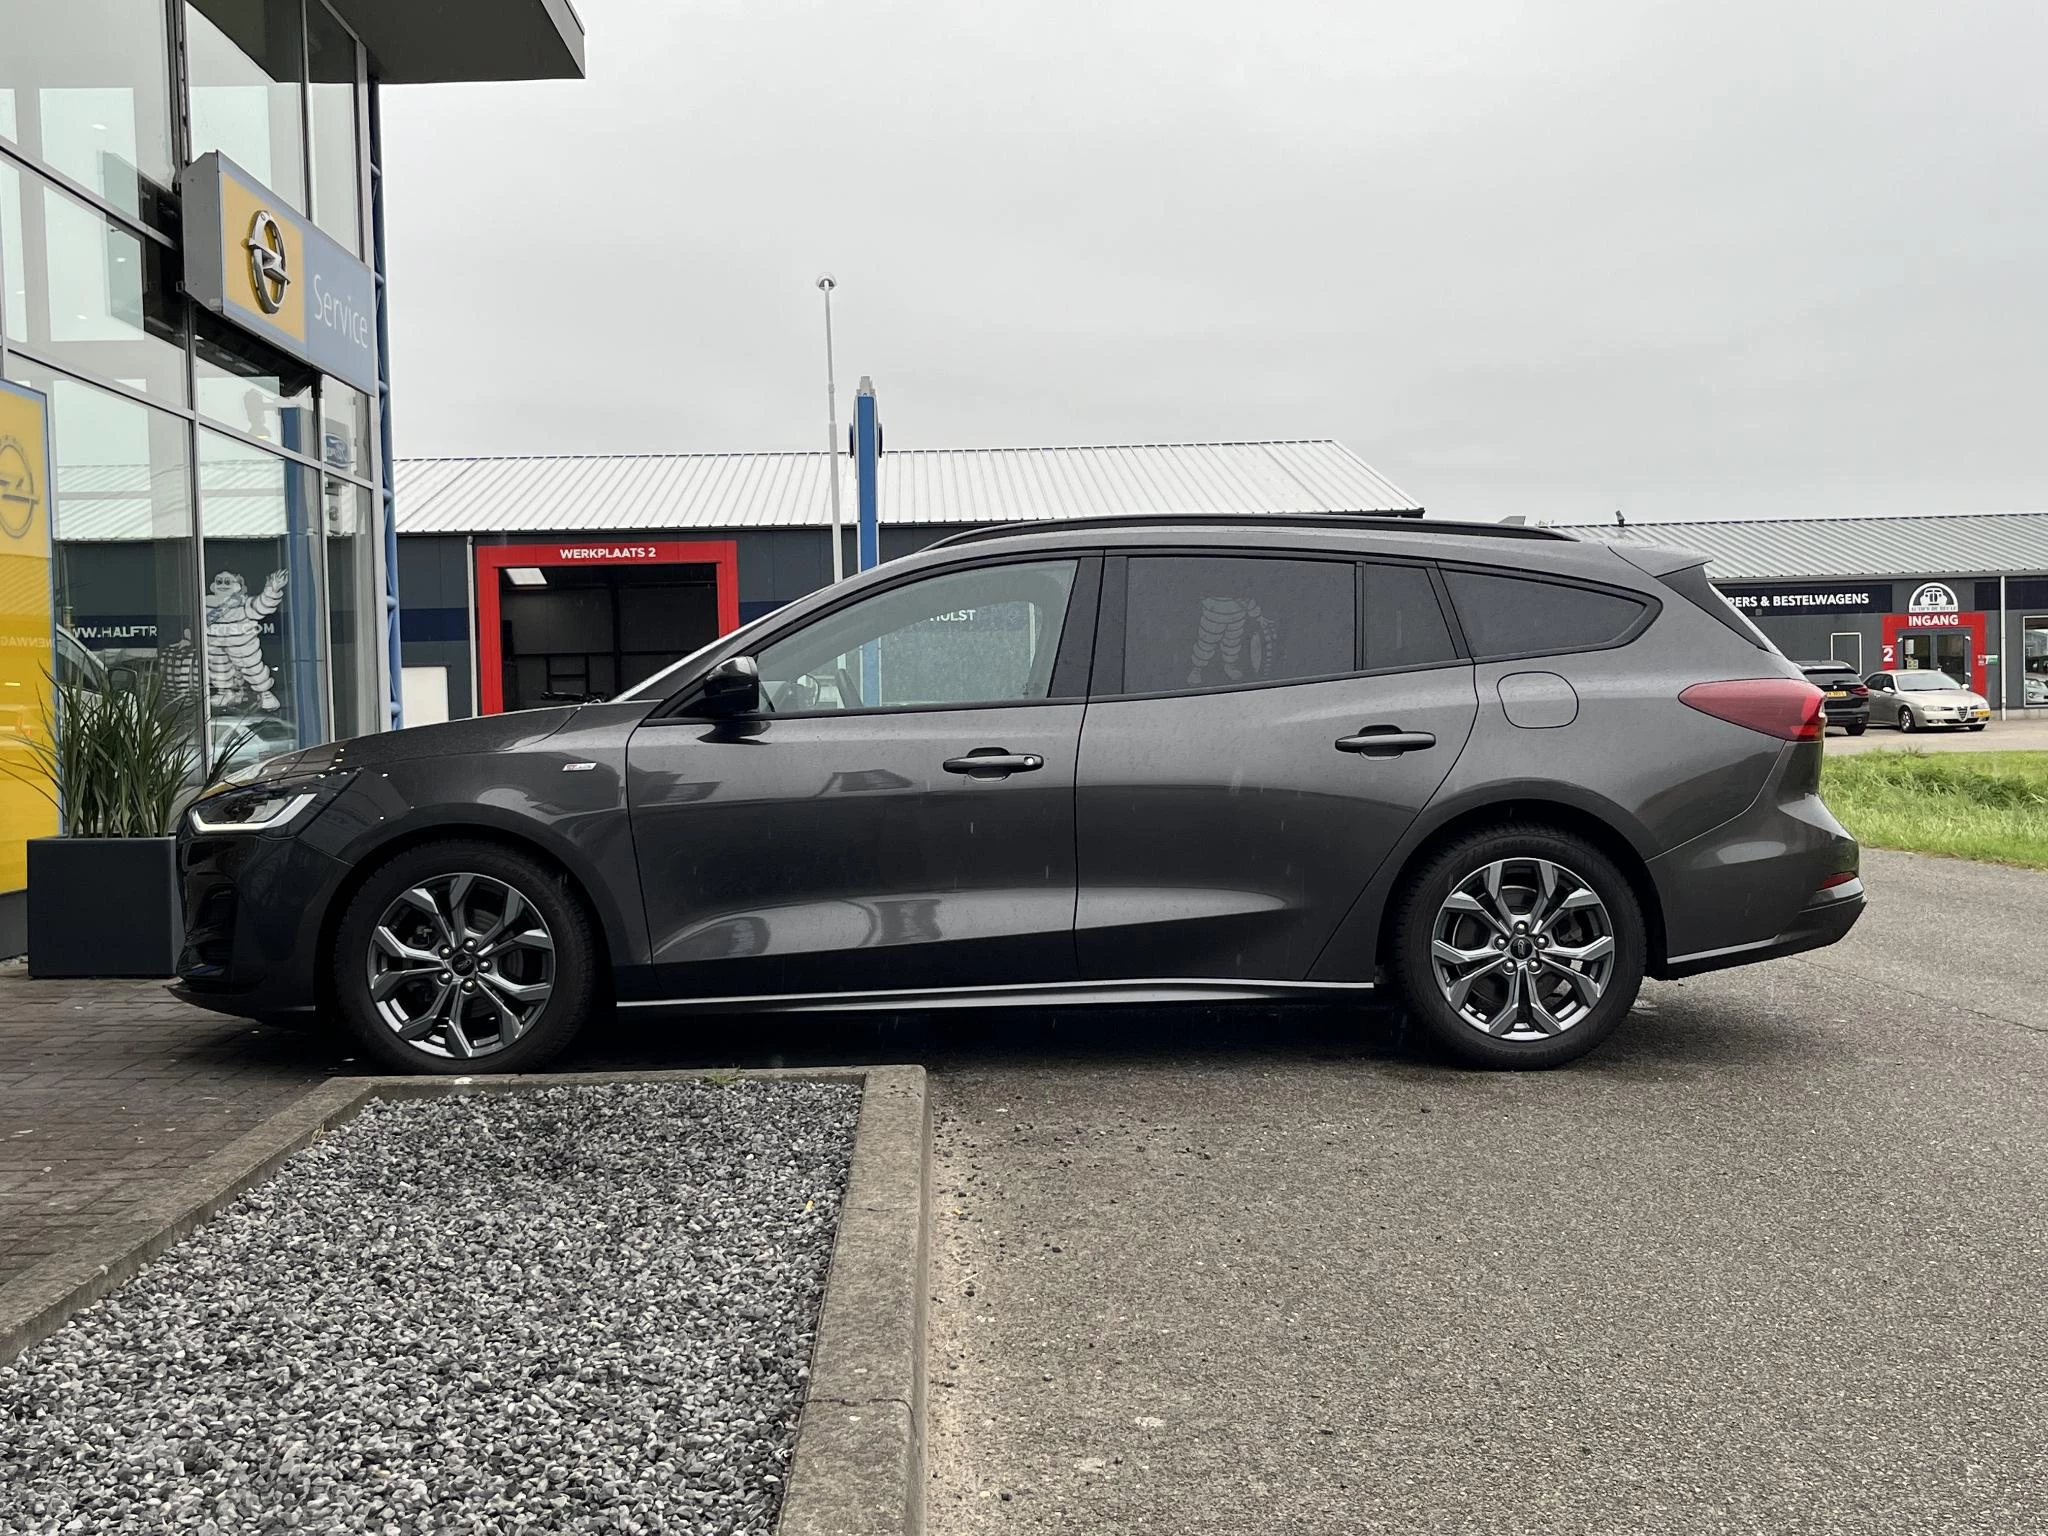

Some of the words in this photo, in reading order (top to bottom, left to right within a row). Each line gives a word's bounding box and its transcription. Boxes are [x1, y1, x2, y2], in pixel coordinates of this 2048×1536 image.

[314, 274, 368, 349] Service
[560, 548, 646, 559] WERKPLAATS
[648, 547, 656, 557] 2
[1760, 596, 1770, 606] &
[1773, 593, 1870, 607] BESTELWAGENS
[1908, 614, 1959, 627] INGANG
[1883, 647, 1894, 662] 2
